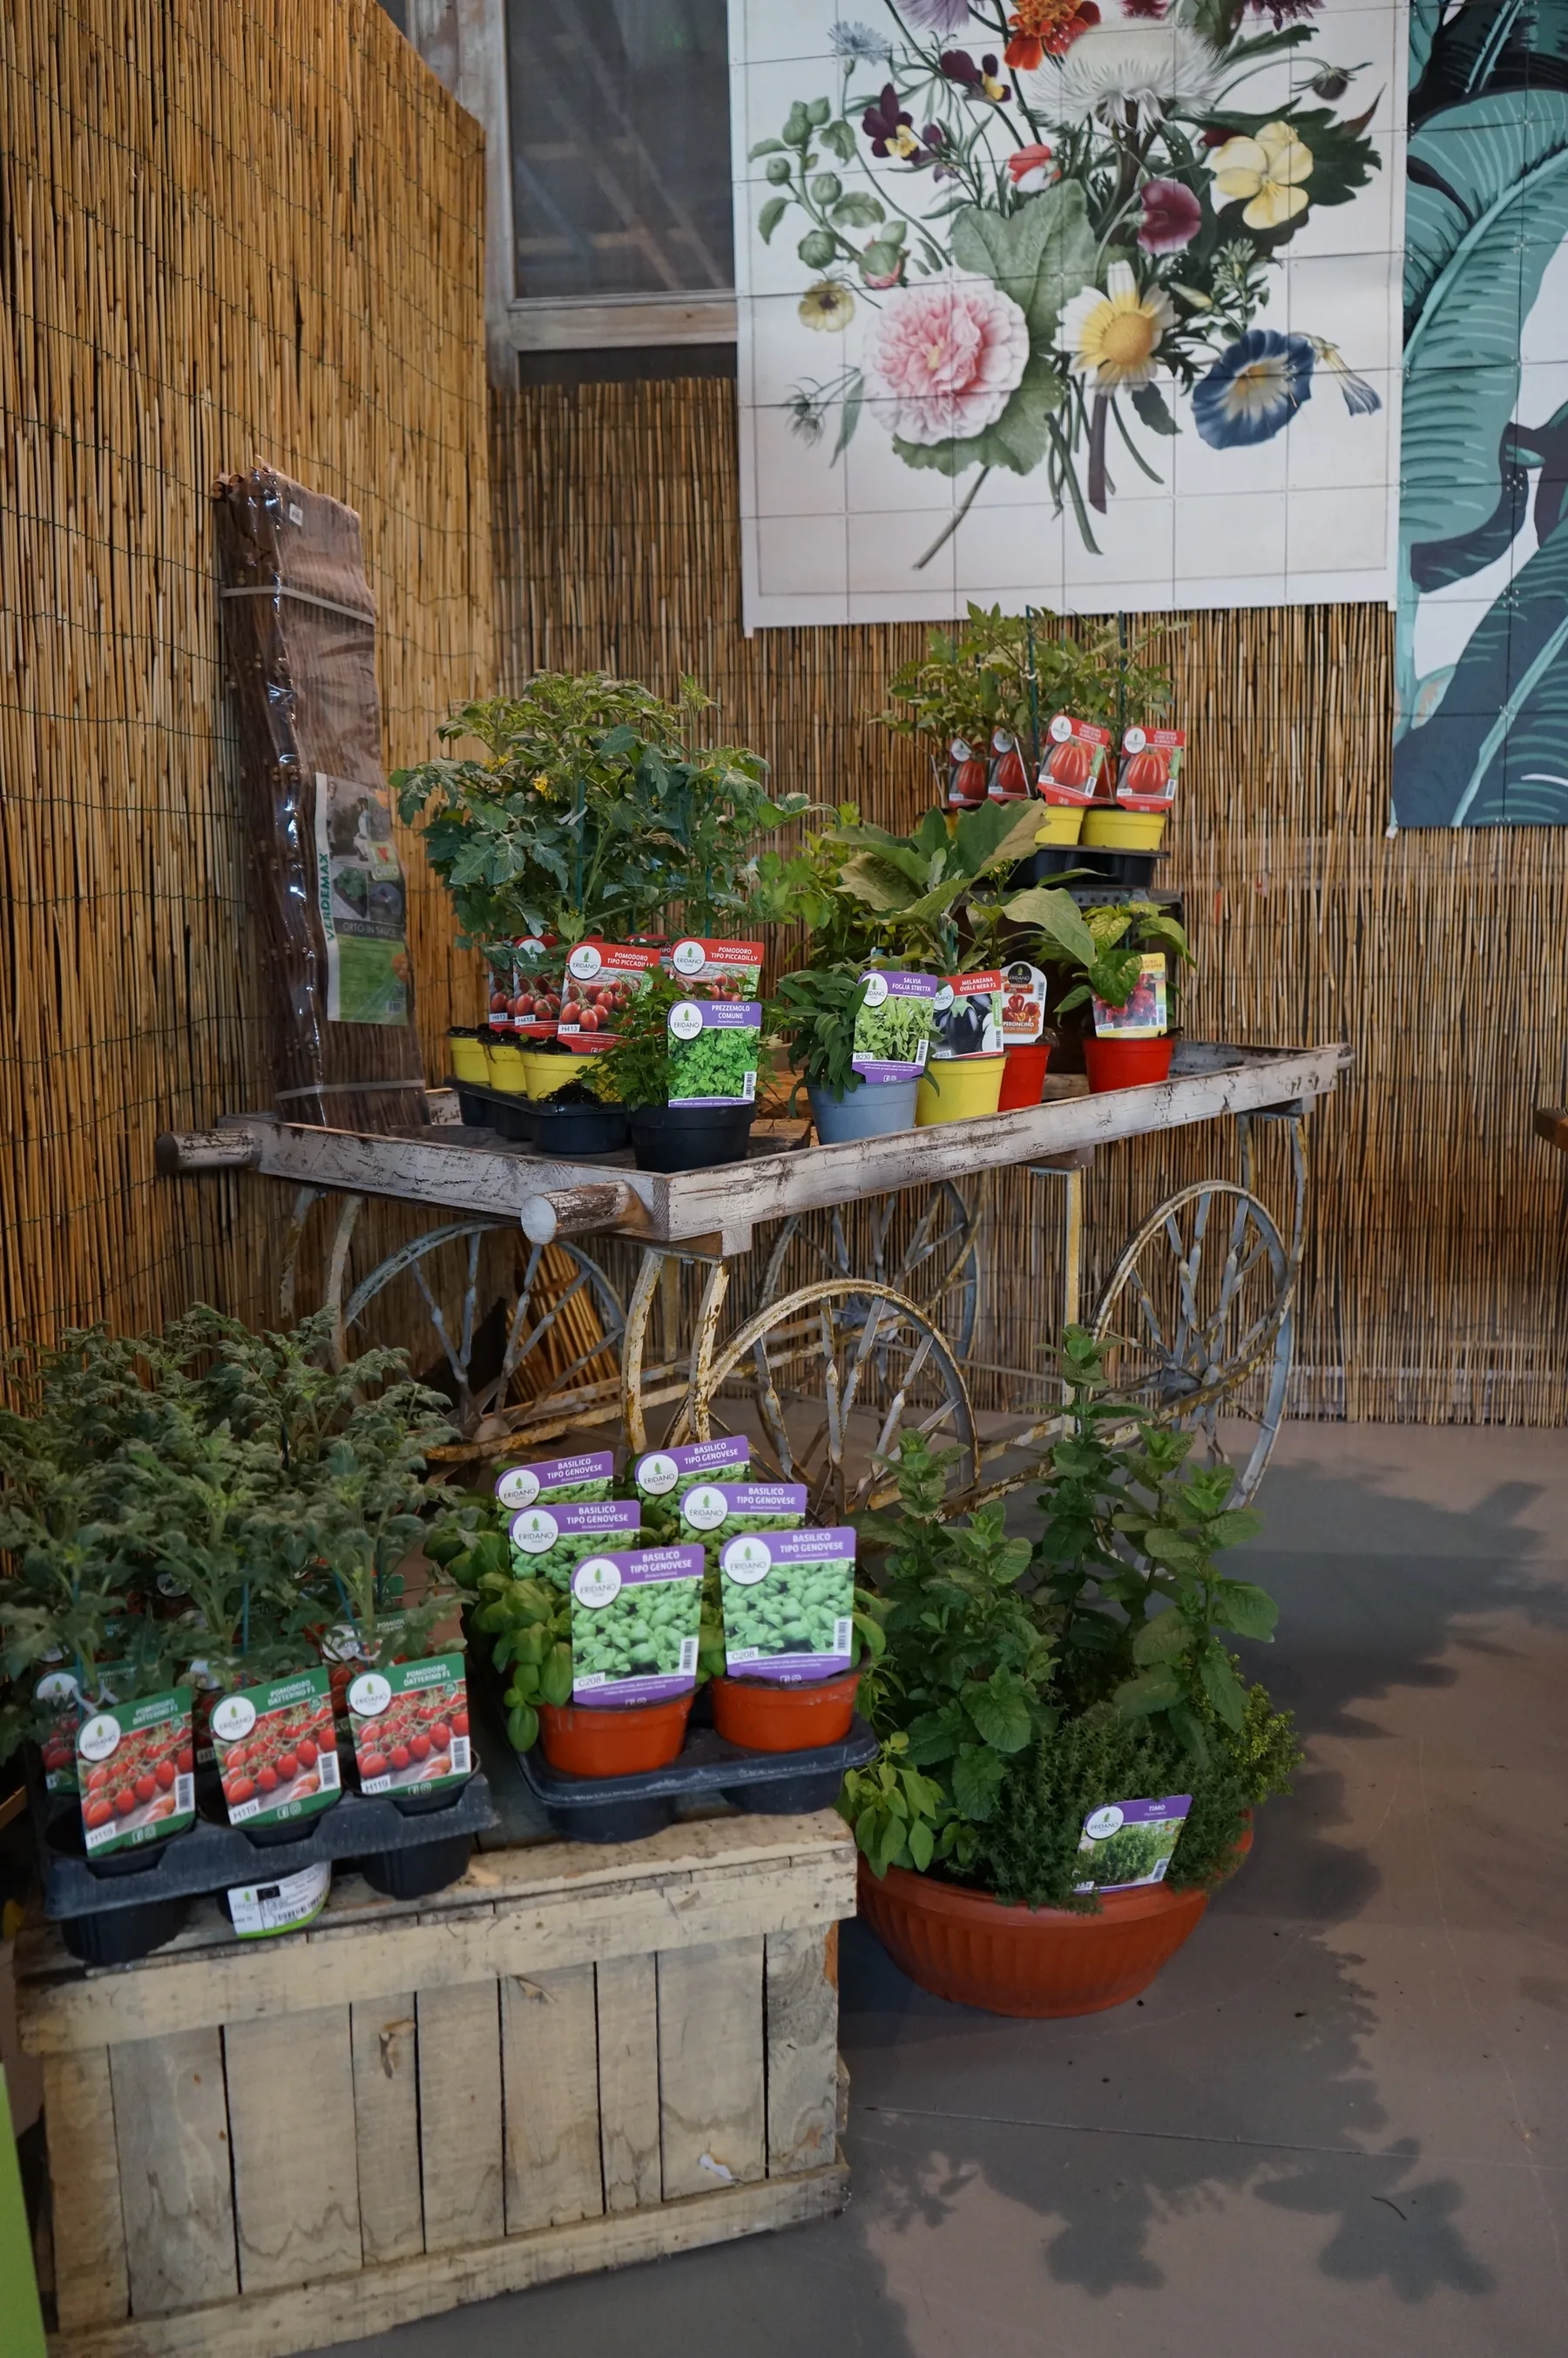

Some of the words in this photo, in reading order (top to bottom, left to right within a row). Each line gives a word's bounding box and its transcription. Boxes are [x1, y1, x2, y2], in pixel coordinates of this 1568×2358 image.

[320, 853, 335, 941] VERDEMAX
[342, 922, 364, 933] ORTO
[366, 924, 375, 934] IN
[718, 946, 752, 955] POMODORO
[614, 952, 648, 961] POMODORO
[962, 976, 993, 986] MELANZANA
[693, 1442, 727, 1455] BASILICO
[684, 1456, 700, 1465] TIPO
[701, 1449, 739, 1462] GENOVESE
[558, 1457, 591, 1470] BASILICO
[547, 1470, 564, 1480] TIPO
[564, 1464, 603, 1477] GENOVESE
[644, 1474, 675, 1484] ERIDANO
[504, 1488, 536, 1499] ERIDANO
[748, 1487, 784, 1496] BASILICO
[736, 1496, 754, 1504] TIPO
[755, 1497, 795, 1505] GENOVESE
[578, 1505, 616, 1515] BASILICO
[689, 1509, 724, 1517] ERIDANO
[586, 1514, 628, 1524] GENOVESE
[518, 1531, 554, 1541] ERIDANO
[793, 1533, 831, 1543] BASILICO
[780, 1544, 799, 1553] TIPO
[801, 1542, 844, 1552] GENOVESE
[642, 1551, 680, 1563] BASILICO
[630, 1564, 649, 1574] TIPO
[650, 1559, 693, 1571] GENOVESE
[730, 1561, 767, 1571] ERIDANO
[580, 1584, 617, 1594] ERIDANO
[376, 1618, 405, 1630] POMOD
[731, 1650, 755, 1661] C208
[406, 1664, 447, 1678] POMODORO
[403, 1672, 442, 1686] DATTERINO
[442, 1670, 451, 1679] F1
[578, 1676, 601, 1687] C208
[270, 1679, 311, 1698] POMODORO
[267, 1690, 306, 1706] DATTERINO
[306, 1686, 315, 1695] F1
[355, 1693, 388, 1706] ERIDANO
[220, 1715, 253, 1730] ERIDANO
[365, 1780, 389, 1794] H119
[233, 1806, 257, 1820] H119
[1091, 1821, 1119, 1830] ERIDANO
[90, 1828, 113, 1844] H119
